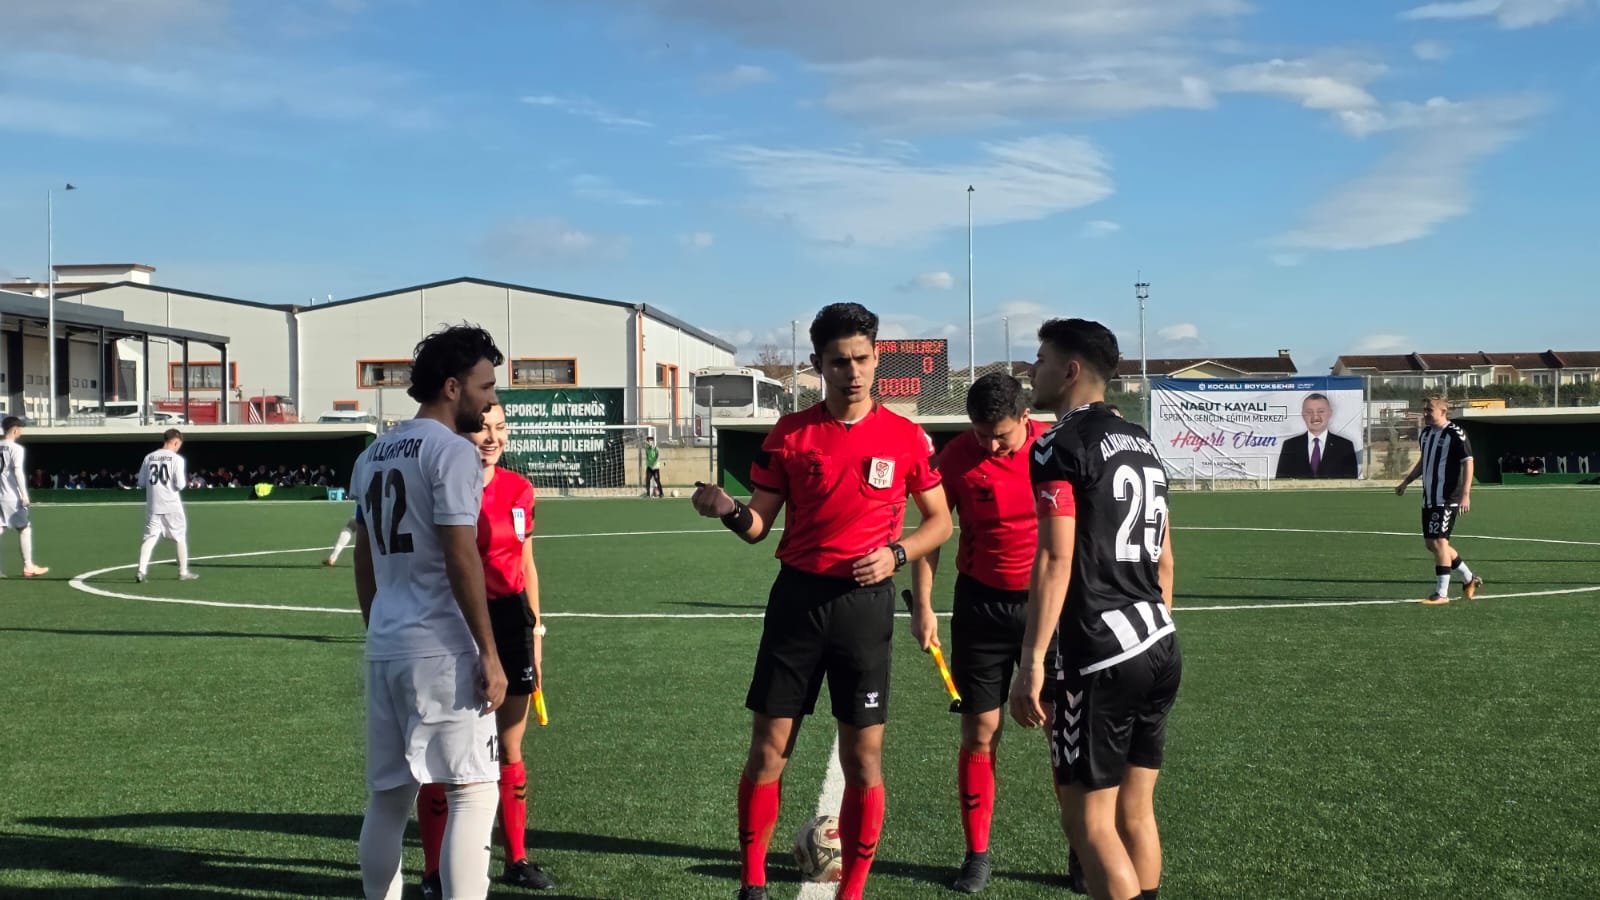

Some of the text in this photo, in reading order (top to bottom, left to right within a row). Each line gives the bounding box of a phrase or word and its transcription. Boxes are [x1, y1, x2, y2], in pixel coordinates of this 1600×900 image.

[505, 403, 549, 418] SPORCU,
[1224, 402, 1267, 412] KAYALI
[1232, 430, 1277, 450] Olsun
[149, 463, 170, 486] 30
[365, 468, 414, 555] 12
[1112, 464, 1167, 563] 25
